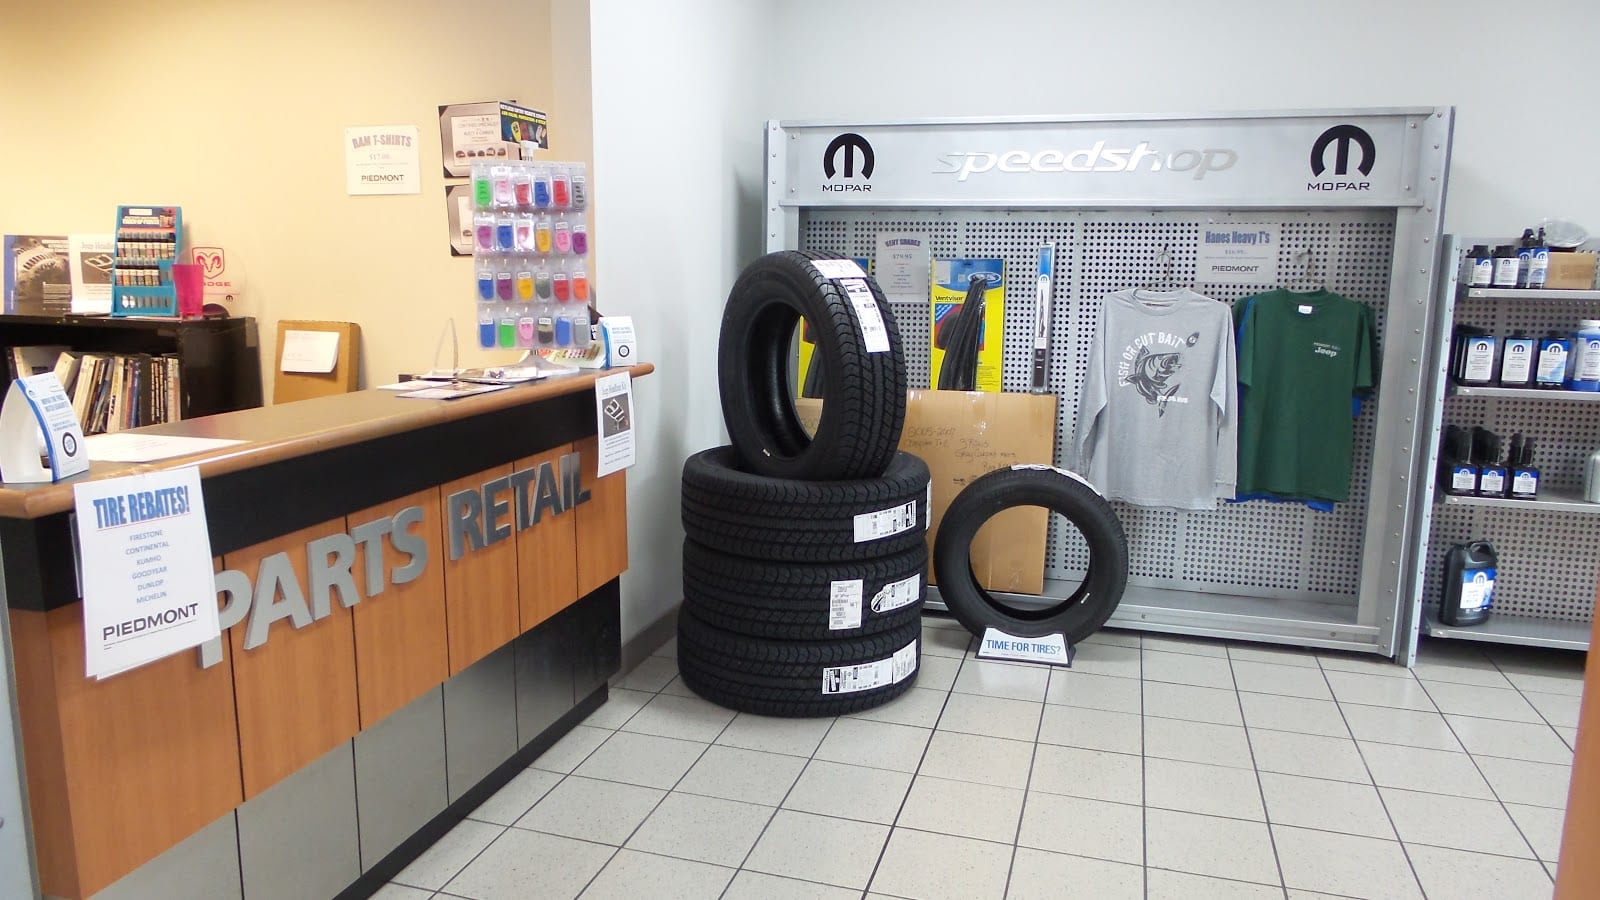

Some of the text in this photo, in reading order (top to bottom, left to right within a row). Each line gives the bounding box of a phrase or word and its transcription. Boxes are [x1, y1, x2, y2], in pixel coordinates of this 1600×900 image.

[352, 134, 412, 149] RAM T-SHIRTS
[932, 140, 1239, 182] speedshop
[361, 174, 405, 182] PIEDMONT
[822, 184, 872, 192] MOPAR
[1307, 182, 1370, 191] MOPAR
[1205, 231, 1270, 245] Hanes Heavy T's
[1122, 345, 1137, 361] OR
[1314, 346, 1337, 358] Jeep
[93, 485, 190, 529] TIRE REBATES!
[129, 529, 163, 542] FIRESTONE
[125, 541, 170, 555] CONTINENTAL
[136, 555, 162, 566] KUMHO
[199, 452, 591, 669] PARTS RETAIL
[131, 566, 168, 580] GOODYEAR
[137, 579, 164, 591] DUNLOP
[136, 591, 167, 604] MICHELIN
[103, 603, 198, 641] PIEDMONT
[986, 638, 1061, 656] TIME FOR TIRES?
